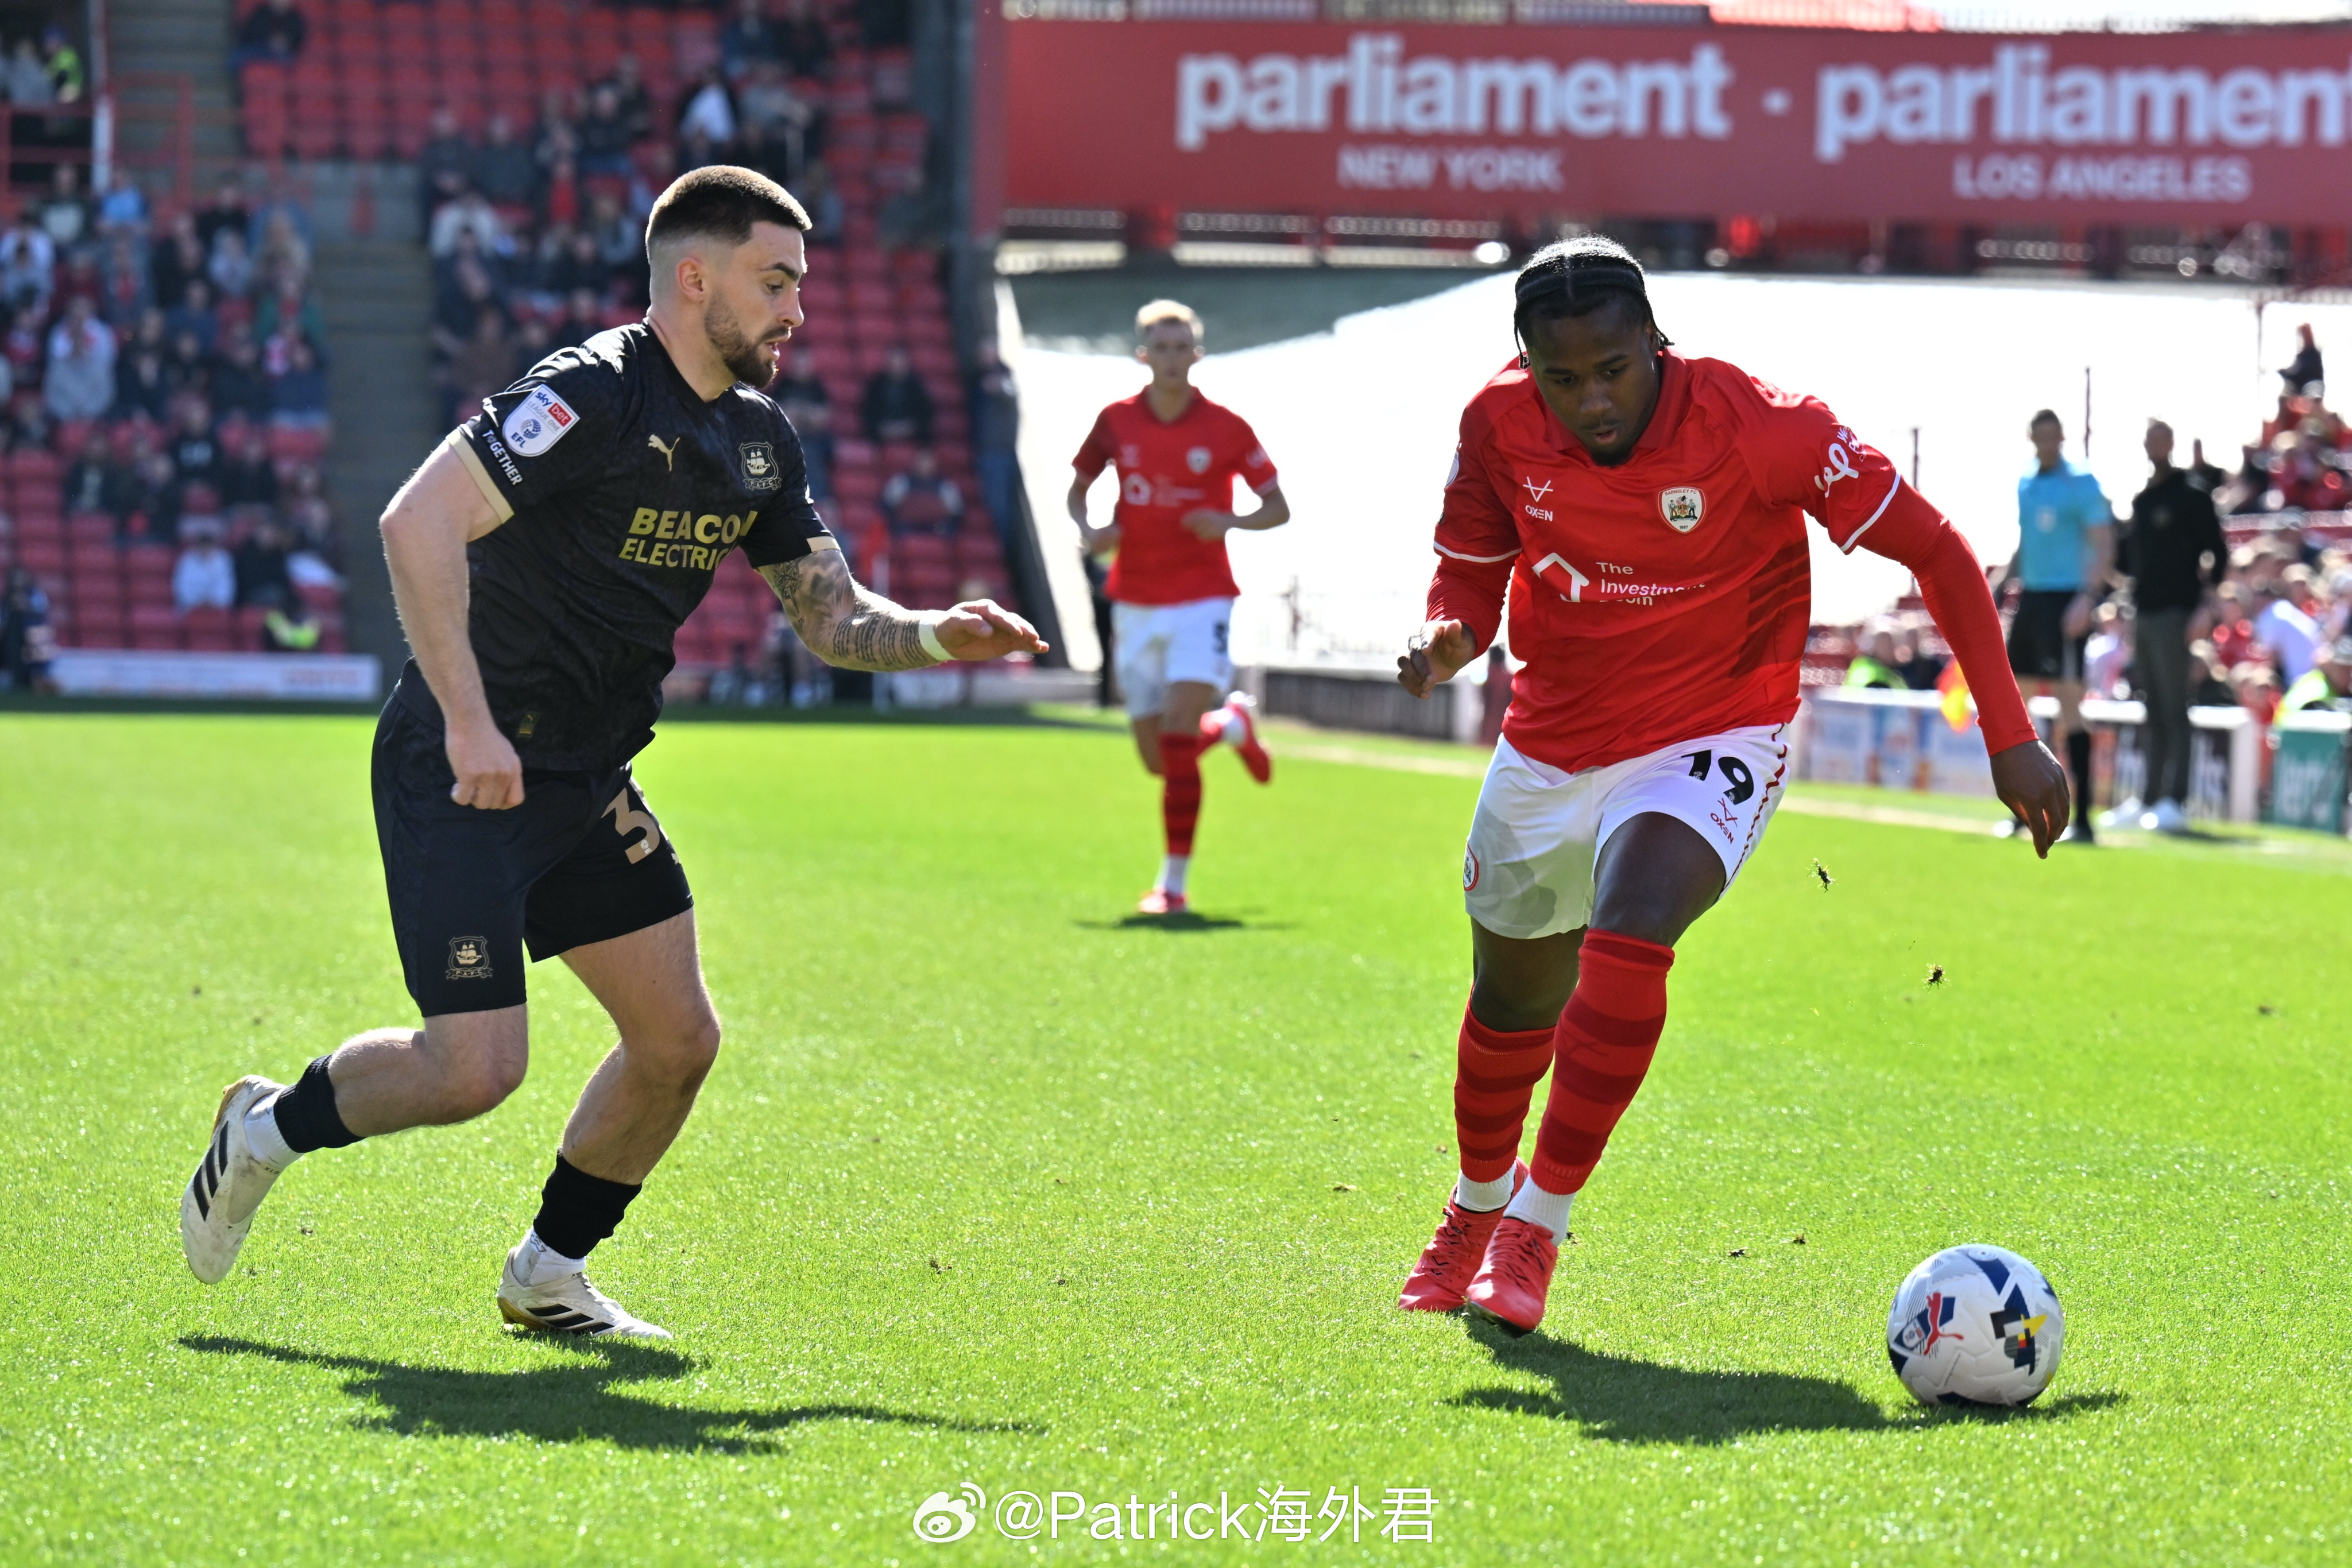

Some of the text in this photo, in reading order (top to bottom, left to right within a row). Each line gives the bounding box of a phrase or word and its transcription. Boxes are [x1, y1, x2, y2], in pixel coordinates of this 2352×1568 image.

[1176, 33, 2352, 161] parliament parliamen
[1337, 148, 1564, 192] NEW YORK
[1953, 154, 2251, 202] LOS ANGELES
[528, 401, 560, 431] LEAGUE ONE
[535, 392, 569, 424] sky bet
[482, 429, 523, 485] TOGETHER
[510, 432, 527, 448] EFL
[1525, 505, 1553, 522] OXEN
[1595, 562, 1633, 575] The
[1681, 749, 1754, 805] 19
[601, 787, 660, 864] 3
[1710, 812, 1734, 845] OXEN
